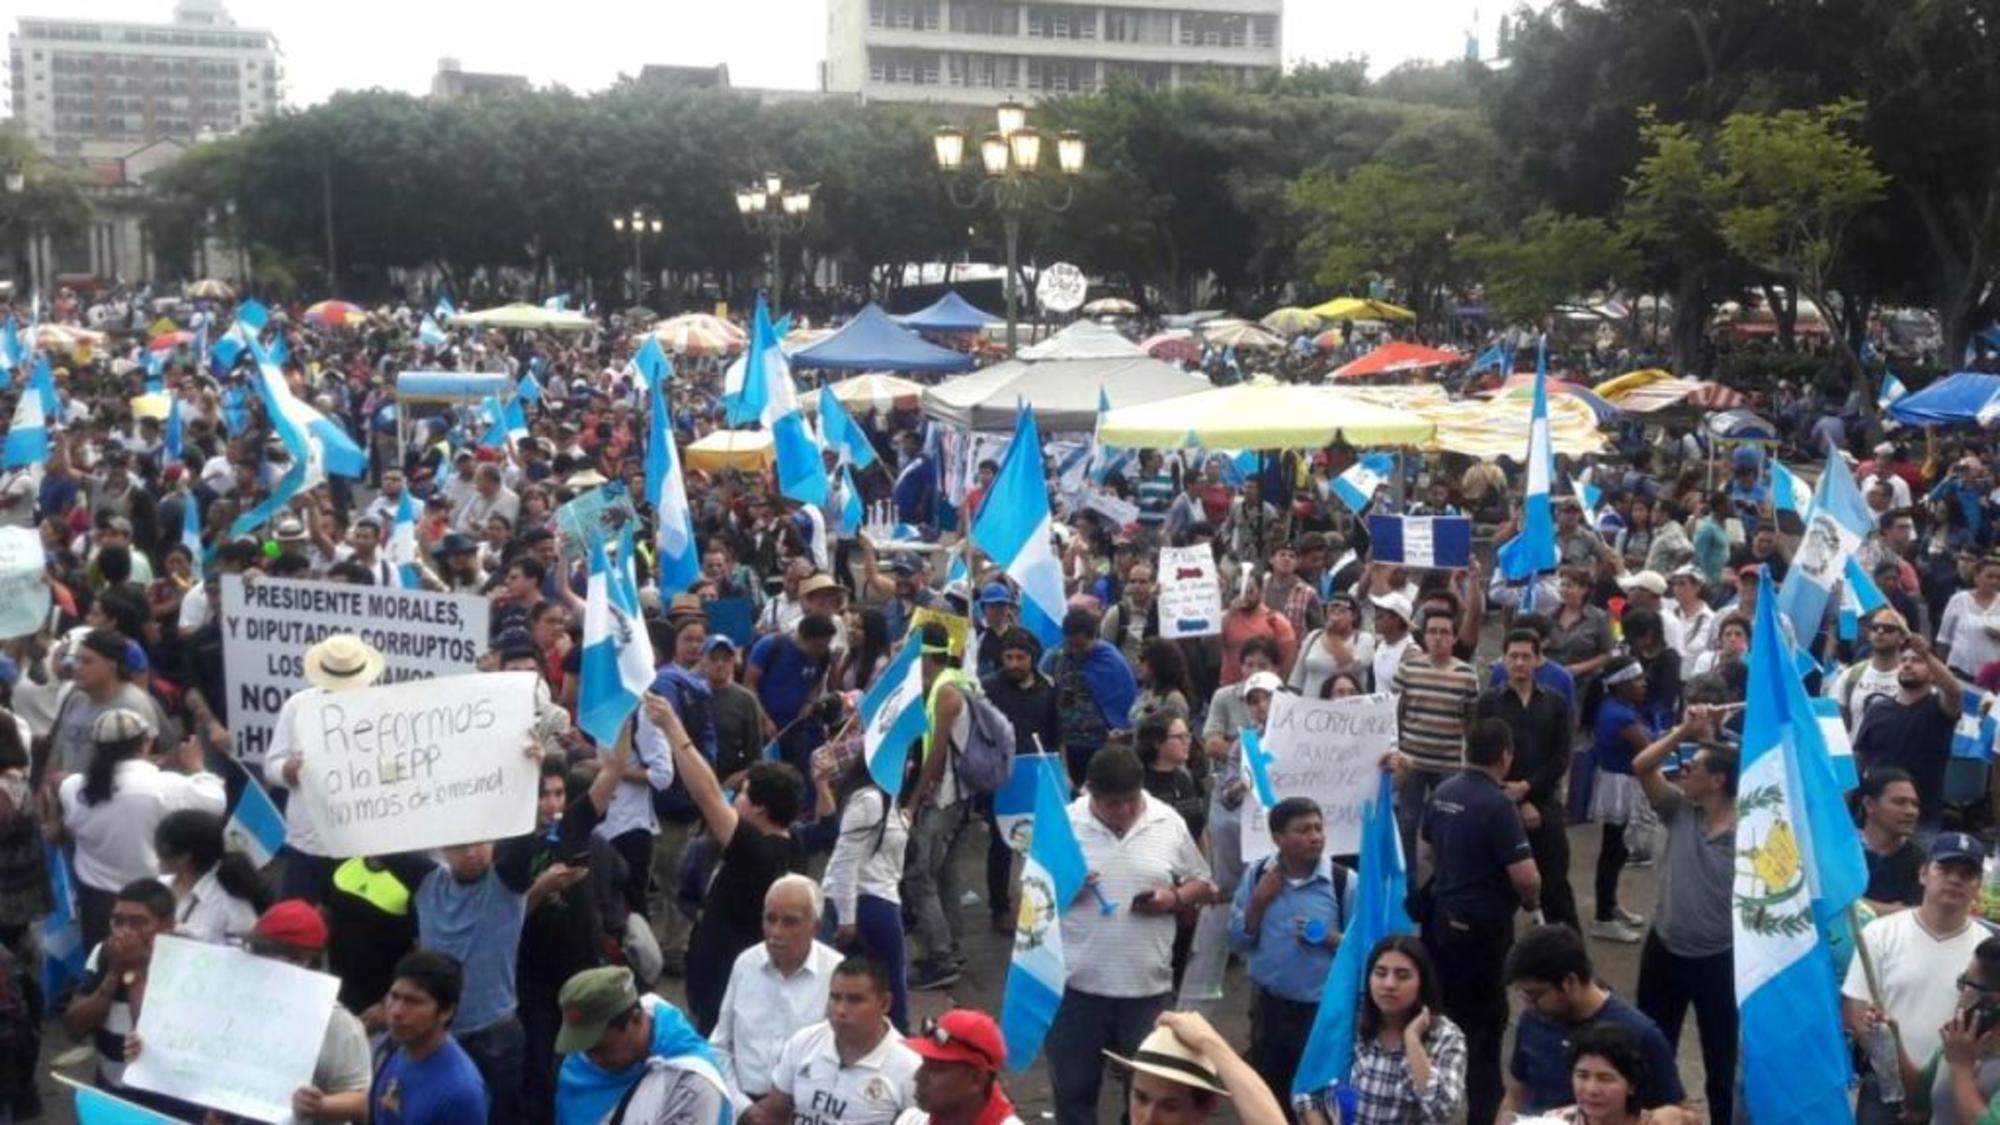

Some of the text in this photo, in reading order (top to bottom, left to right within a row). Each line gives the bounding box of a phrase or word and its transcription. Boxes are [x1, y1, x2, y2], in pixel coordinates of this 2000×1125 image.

[244, 584, 465, 633] PRESIDENTE MORALES,
[227, 616, 240, 639] Y
[268, 653, 304, 678] LOS
[376, 743, 442, 785] LEPP
[811, 1089, 848, 1120] Fly
